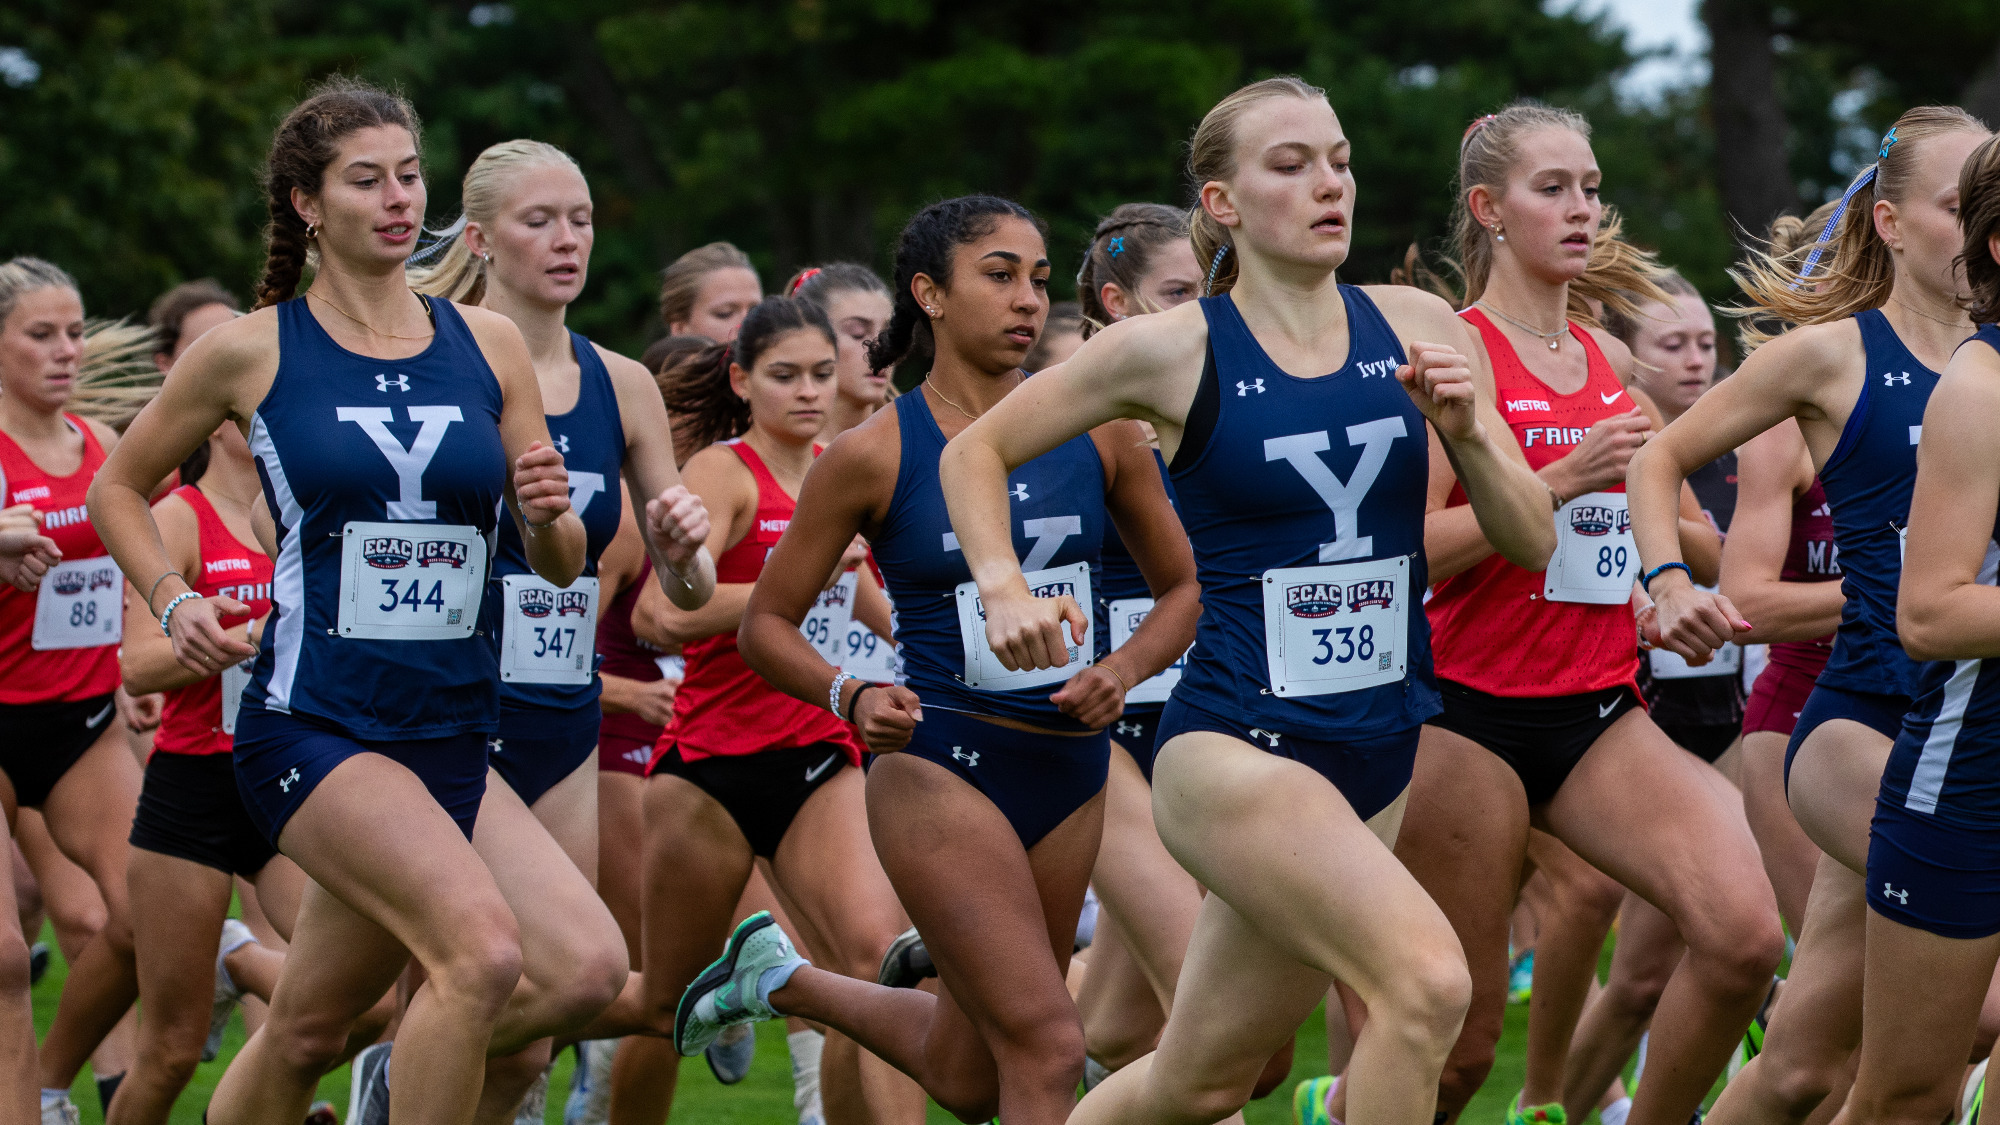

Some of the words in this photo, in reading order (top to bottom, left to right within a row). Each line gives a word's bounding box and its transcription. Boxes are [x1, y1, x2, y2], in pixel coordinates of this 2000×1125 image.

[1357, 359, 1387, 379] Ivy
[1506, 399, 1551, 413] METRO
[1524, 427, 1592, 448] FAIR
[336, 405, 464, 520] Y
[1264, 415, 1407, 564] Y
[1572, 507, 1613, 524] ECAC
[363, 537, 412, 557] ECAC
[417, 541, 466, 560] IC4A
[1596, 545, 1627, 578] 89
[205, 558, 250, 574] METRO
[378, 578, 445, 613] 344
[519, 589, 553, 606] ECAC
[557, 592, 588, 609] IC4A
[1288, 584, 1341, 606] ECAC
[1348, 580, 1393, 605] IC4A
[69, 600, 97, 627] 88
[533, 627, 577, 660] 347
[806, 617, 830, 645] 95
[847, 630, 877, 658] 99
[1312, 623, 1375, 665] 338
